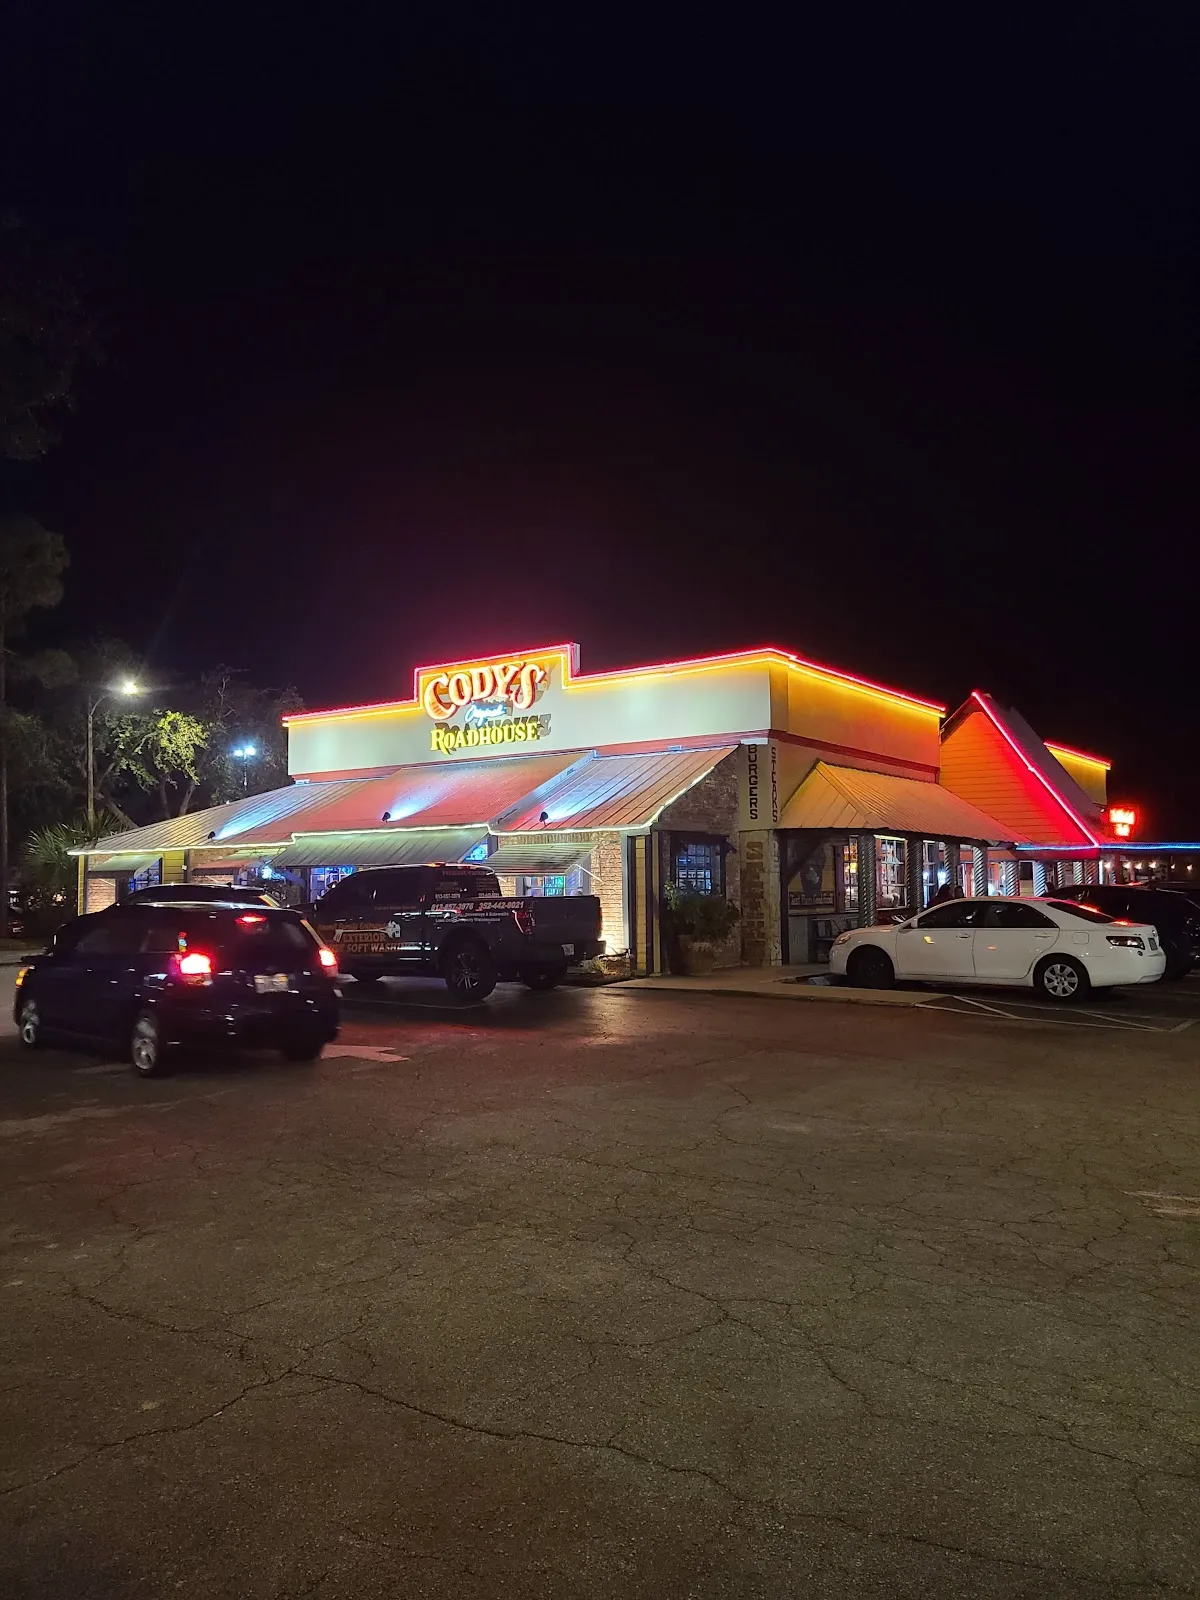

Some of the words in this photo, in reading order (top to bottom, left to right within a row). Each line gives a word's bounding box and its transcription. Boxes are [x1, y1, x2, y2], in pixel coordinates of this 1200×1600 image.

[423, 661, 547, 720] CODY'S
[430, 722, 540, 755] ROADHOUSE
[748, 744, 758, 820] BURGERS
[344, 933, 386, 942] EXTERIOR
[346, 943, 368, 952] SOFT
